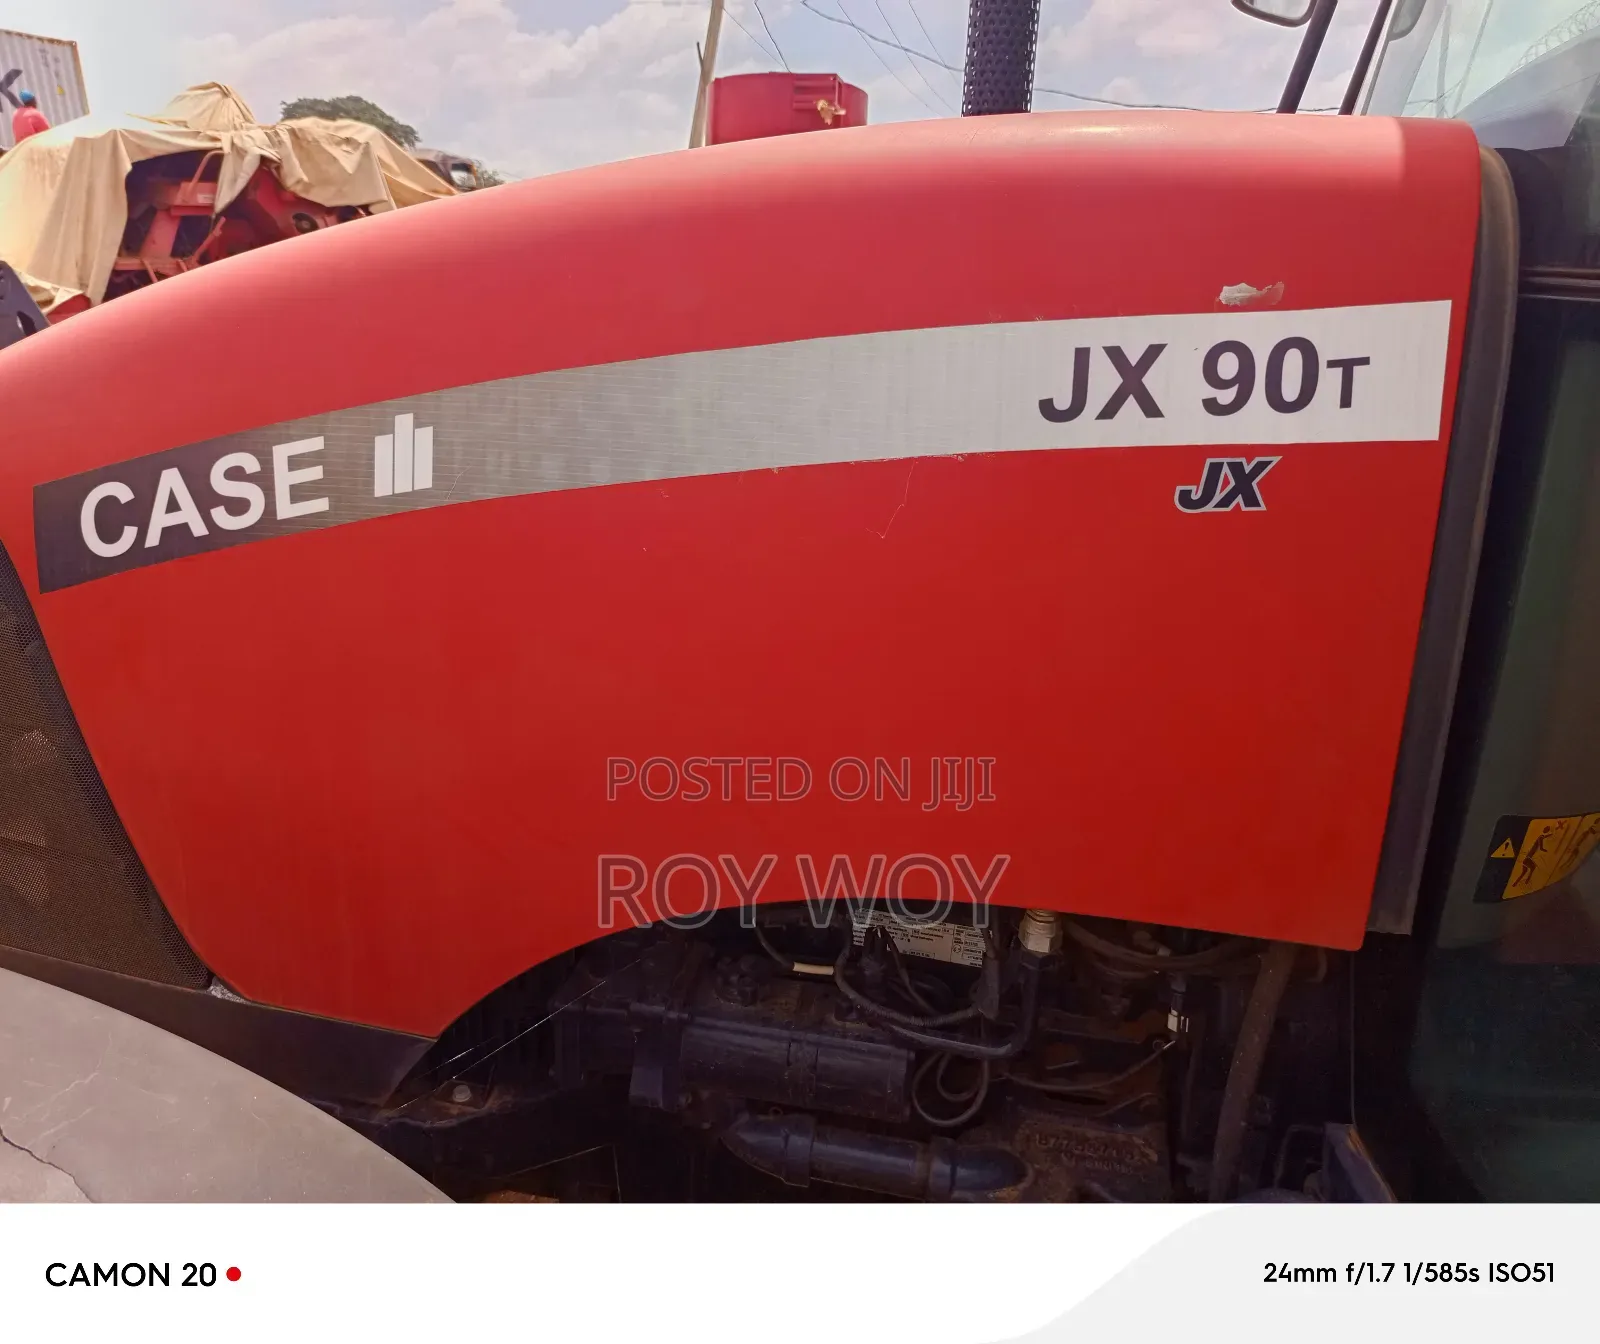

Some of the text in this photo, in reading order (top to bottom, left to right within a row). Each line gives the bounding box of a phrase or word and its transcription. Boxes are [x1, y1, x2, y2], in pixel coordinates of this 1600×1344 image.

[1038, 342, 1168, 424] JX
[79, 435, 330, 558] CASE
[1174, 456, 1283, 514] JX
